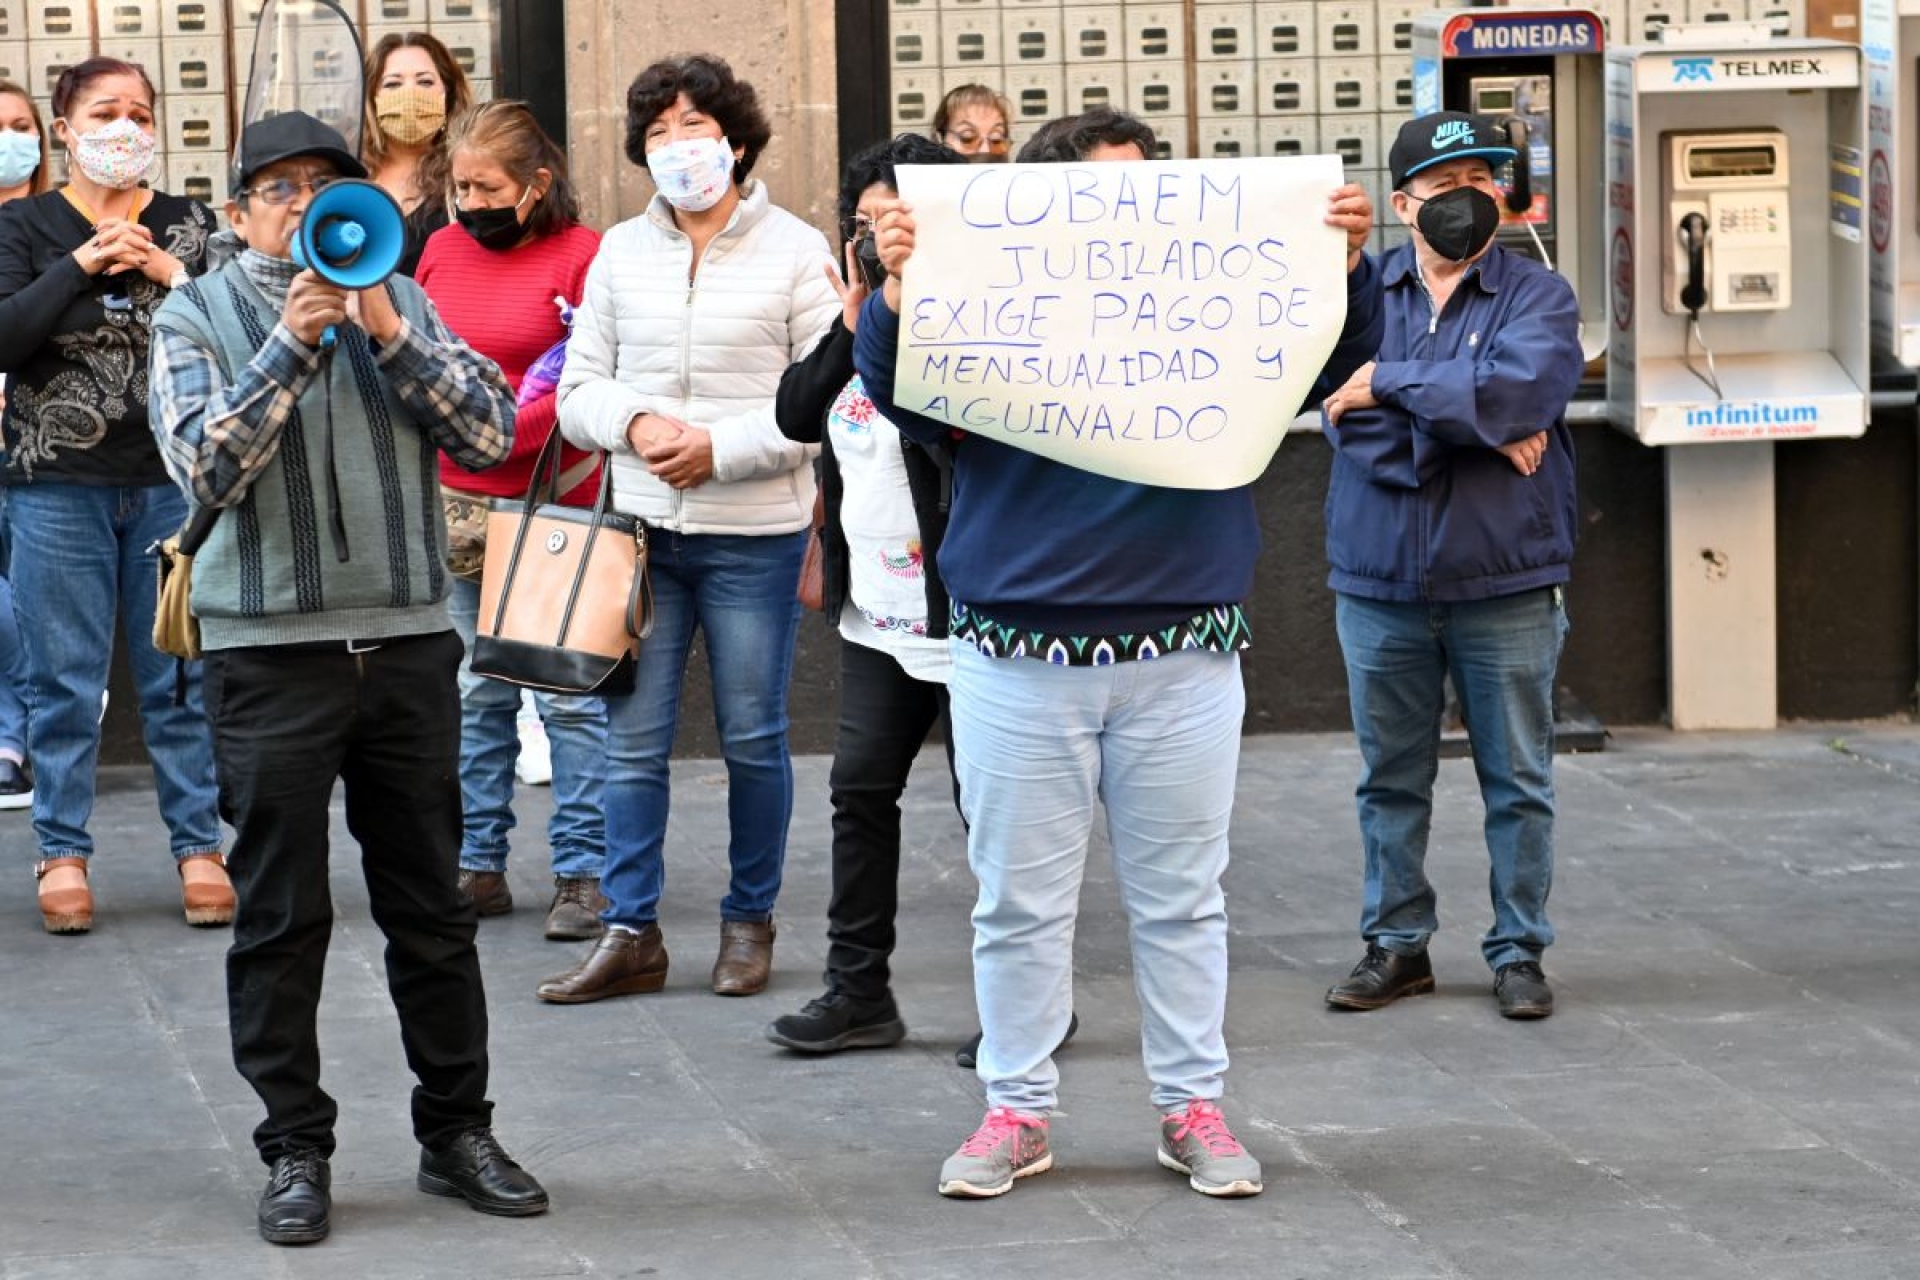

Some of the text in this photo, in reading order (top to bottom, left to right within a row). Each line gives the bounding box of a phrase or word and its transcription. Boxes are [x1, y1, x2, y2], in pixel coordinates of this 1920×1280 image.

[1472, 23, 1589, 49] MONEDAS
[1721, 58, 1822, 77] TELMEX
[1436, 121, 1470, 139] NIKE
[960, 168, 1243, 232] COBAEM
[987, 238, 1290, 290] JUBILADOS
[909, 287, 1313, 341] EXIGE PAGO DE
[921, 349, 1220, 389] MENSUALIDAD
[920, 395, 1229, 444] AGUINALDO
[1687, 402, 1818, 426] infinitum
